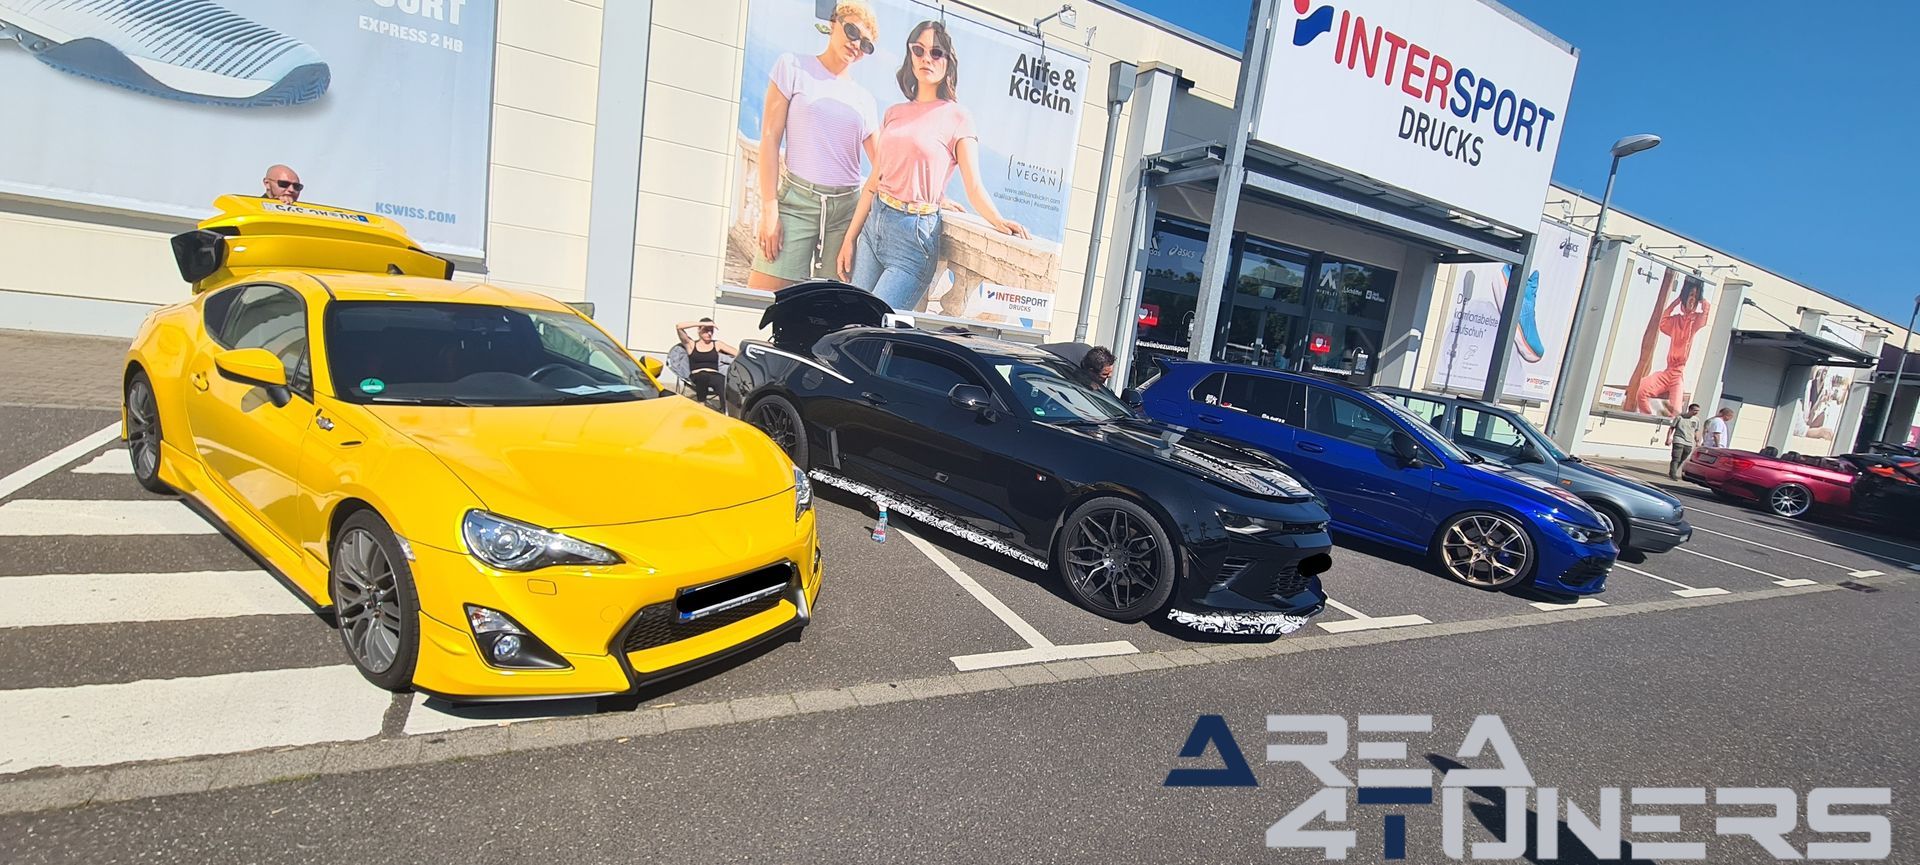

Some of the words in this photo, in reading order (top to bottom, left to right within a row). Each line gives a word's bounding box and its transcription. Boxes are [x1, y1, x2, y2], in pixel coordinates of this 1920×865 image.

[359, 15, 428, 44] EXPRESS
[430, 33, 440, 47] 2
[443, 36, 464, 53] HB
[1012, 53, 1061, 87] Alife
[1062, 69, 1077, 93] &
[1334, 9, 1555, 153] INTERSPORT
[1009, 74, 1072, 114] Kickin
[1398, 105, 1484, 167] DRUCKS
[1016, 168, 1056, 187] VEGAN
[375, 201, 456, 224] KSWISS.COM
[995, 291, 1048, 308] INTERSPORT
[1008, 303, 1031, 313] DRUCKS
